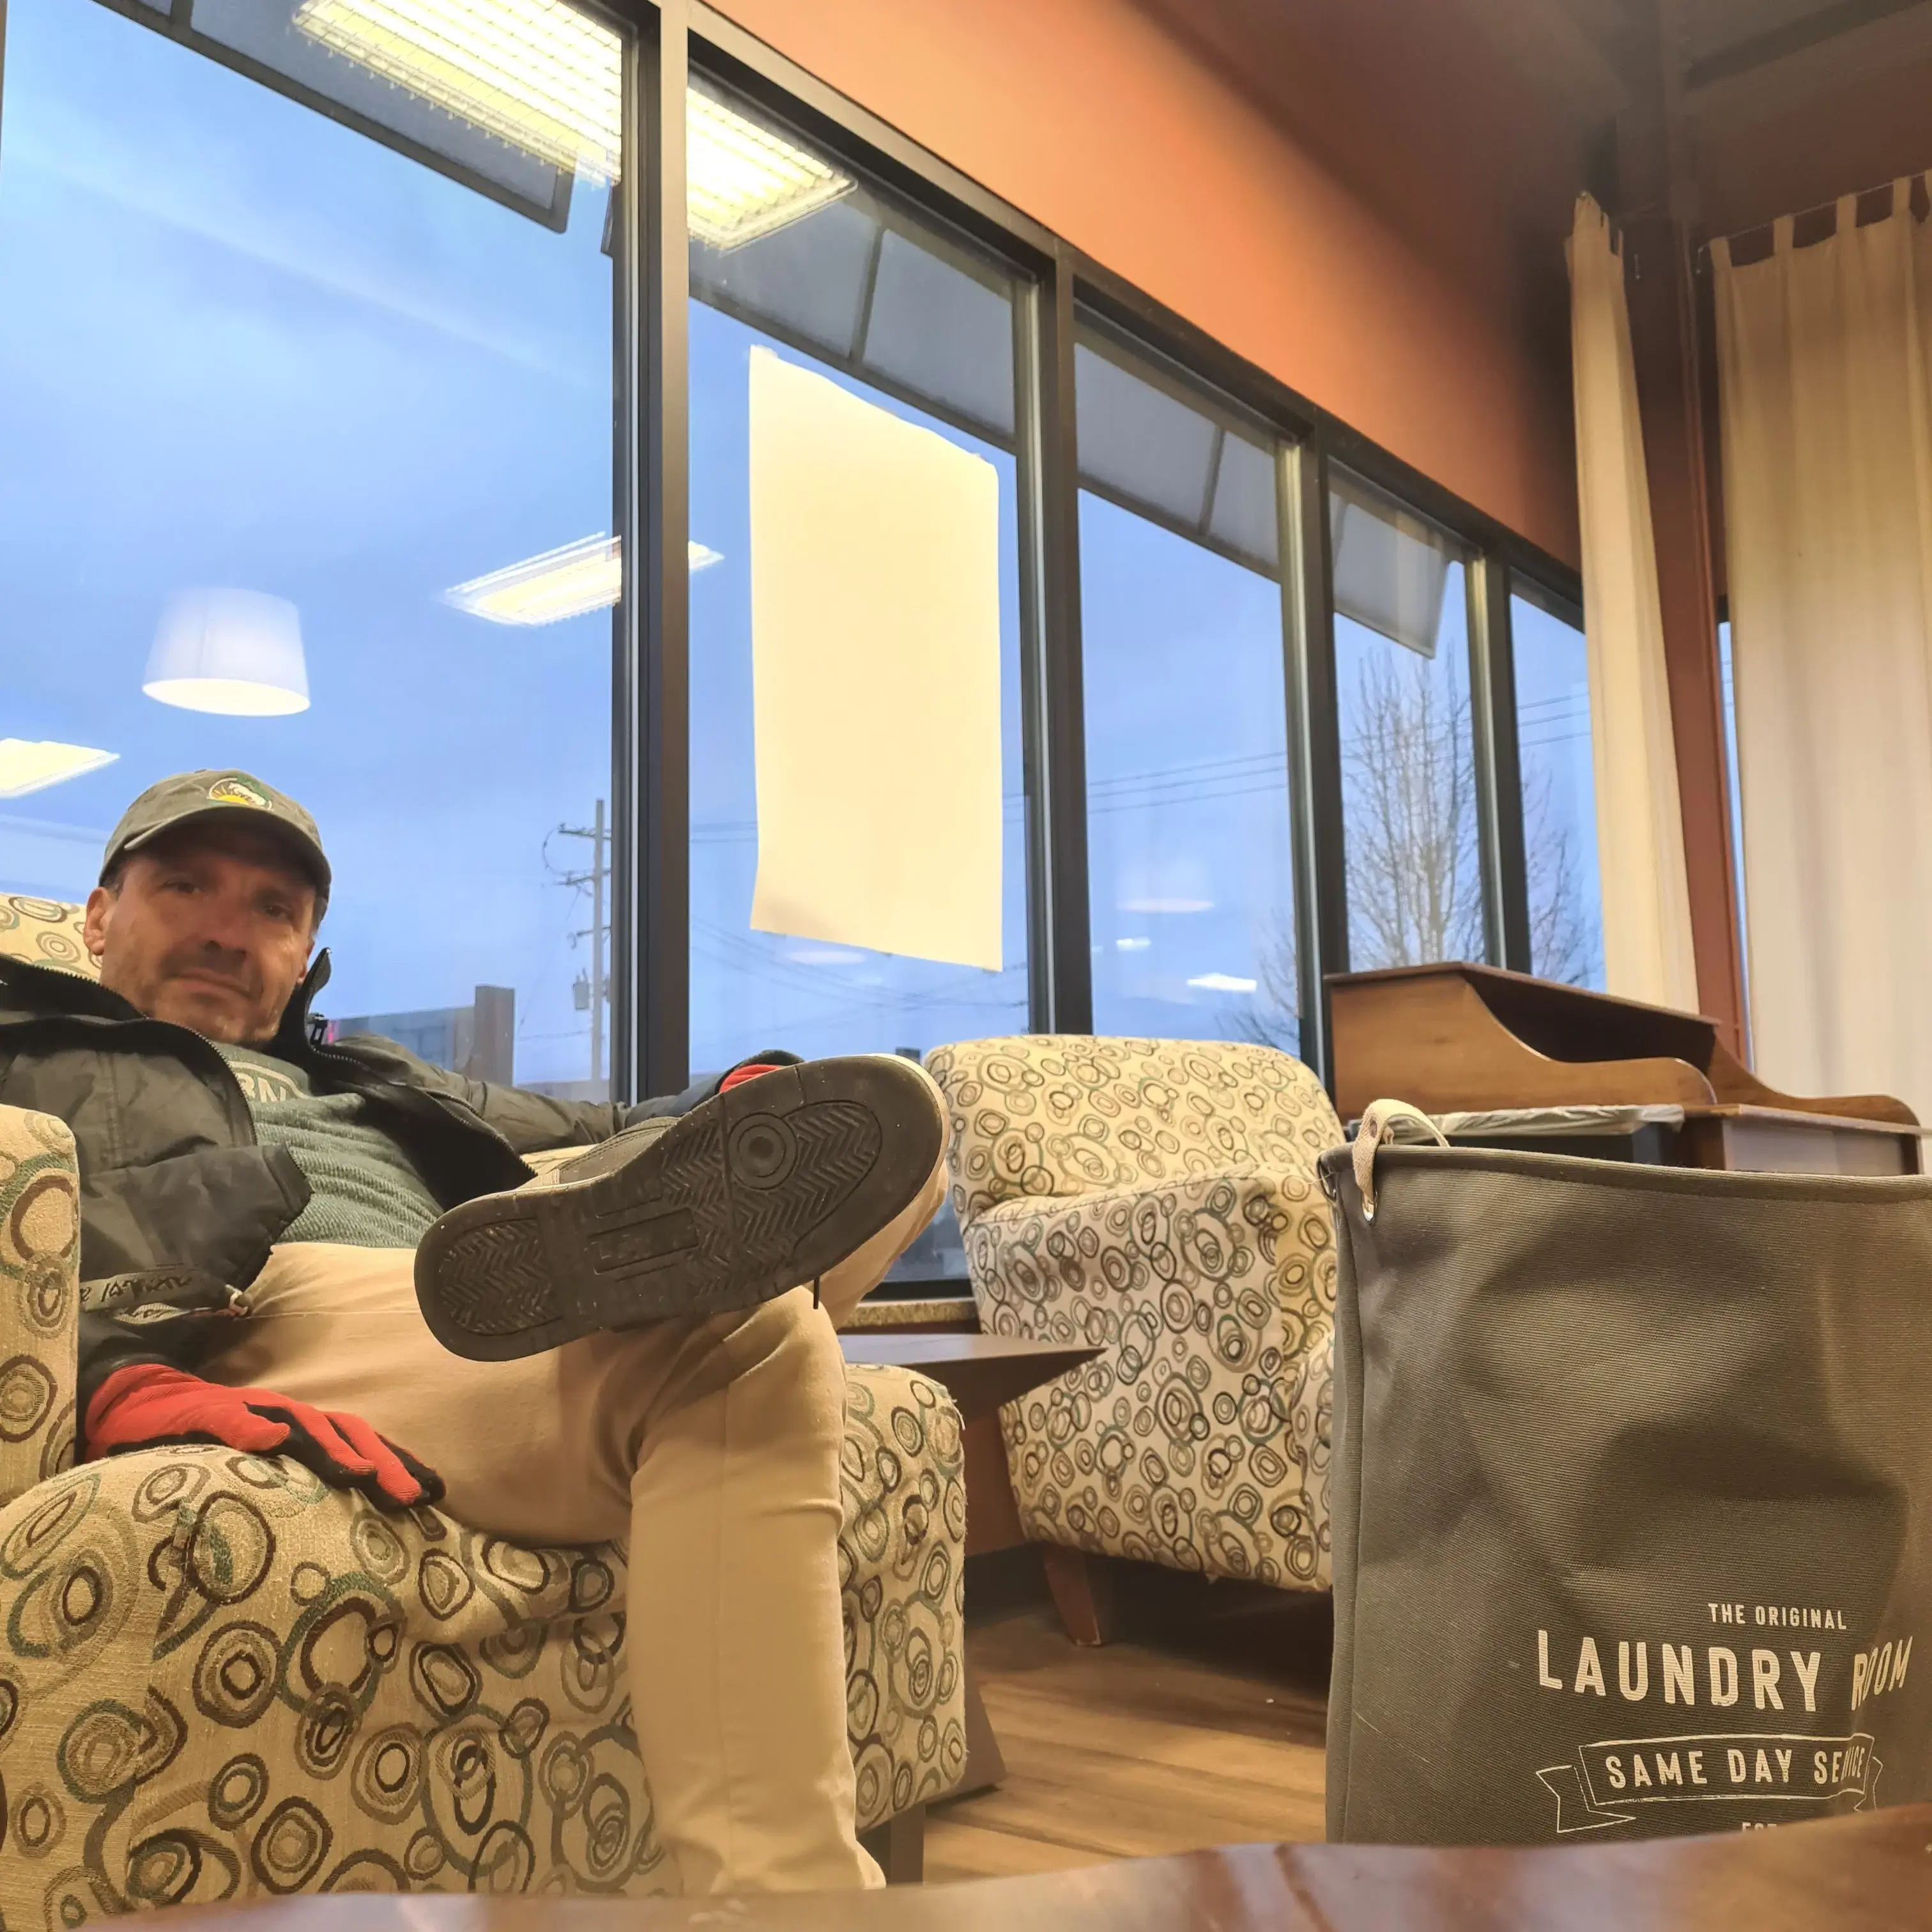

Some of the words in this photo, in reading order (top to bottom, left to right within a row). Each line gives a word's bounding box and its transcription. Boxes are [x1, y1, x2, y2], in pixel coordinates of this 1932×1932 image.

[1708, 1602, 1746, 1625] THE
[1754, 1605, 1848, 1630] ORIGINAL
[1537, 1629, 1821, 1712] LAUNDRY
[1850, 1635, 1913, 1711] ROOM
[1605, 1751, 1708, 1789] SAME
[1727, 1749, 1792, 1783] DAY
